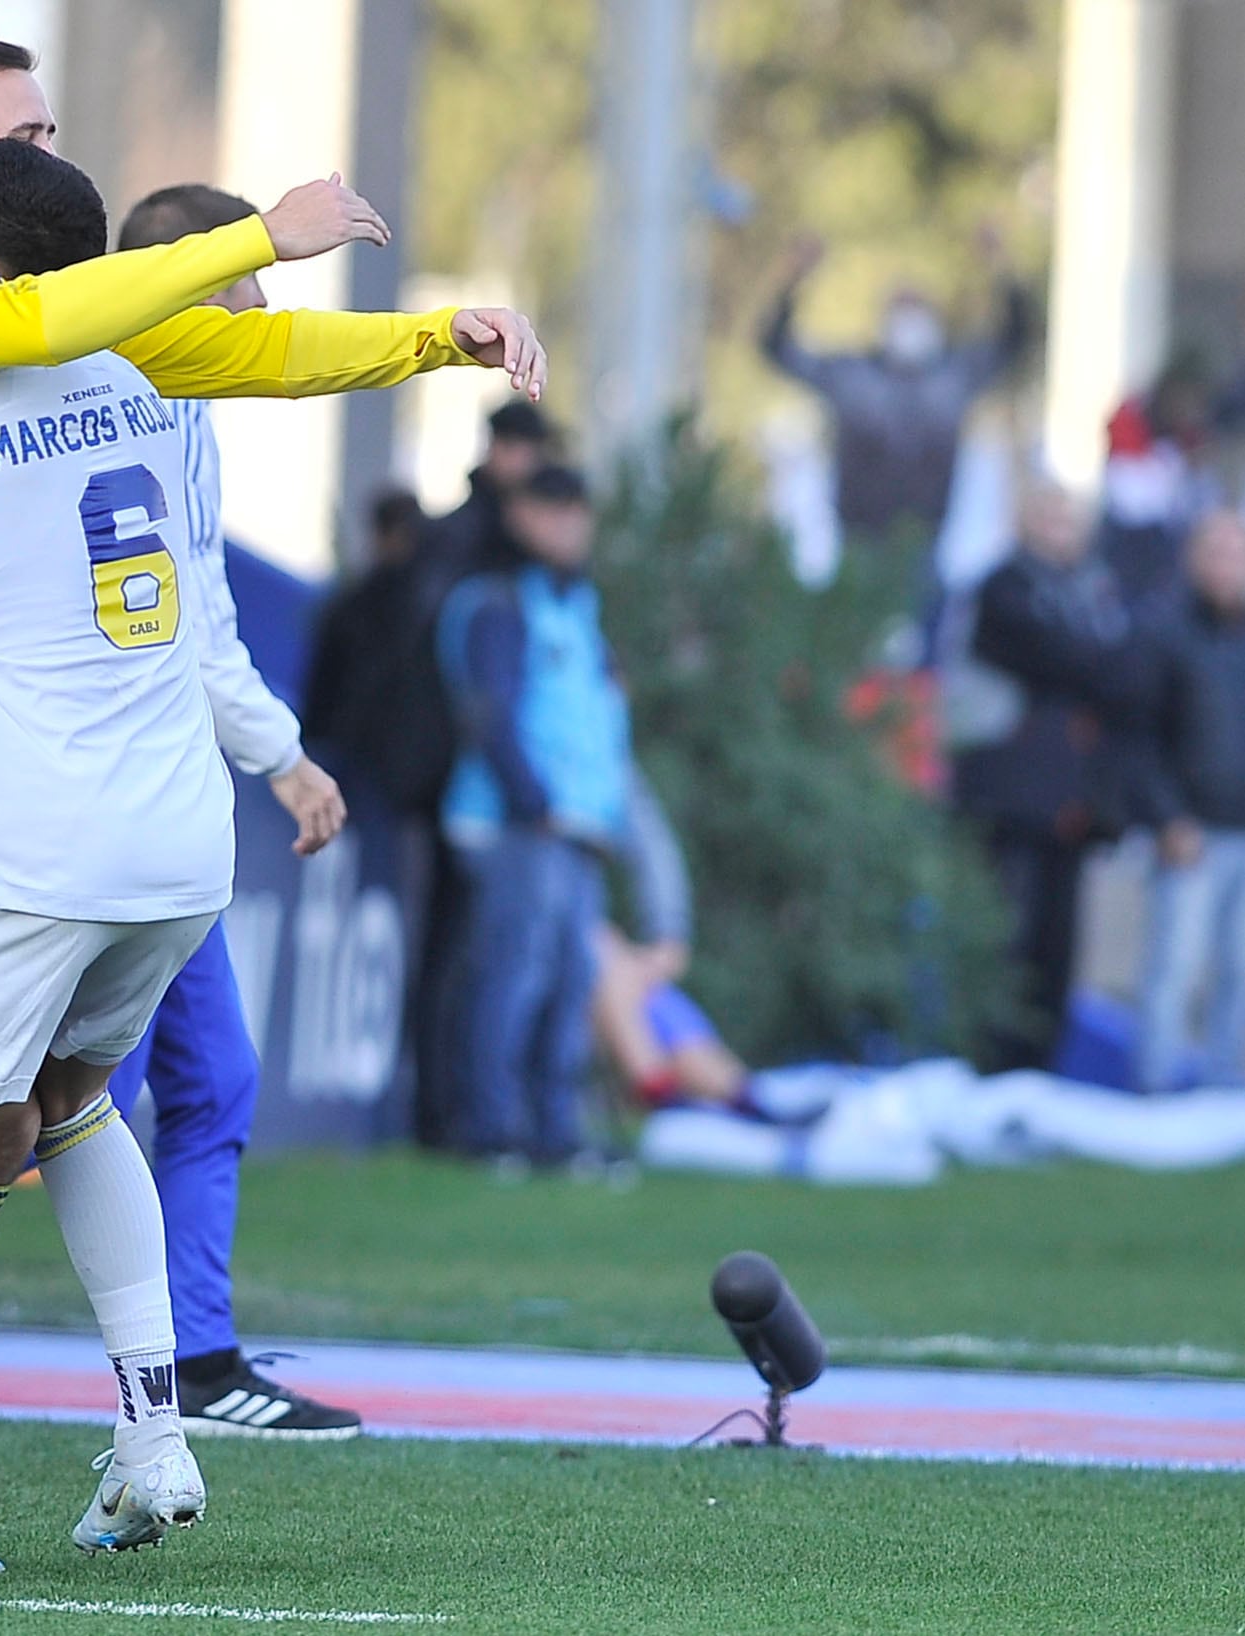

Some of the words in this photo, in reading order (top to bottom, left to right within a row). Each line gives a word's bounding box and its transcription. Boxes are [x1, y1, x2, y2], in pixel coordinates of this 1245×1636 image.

[61, 383, 114, 404] XENEIZE
[77, 463, 181, 651] 6
[129, 620, 160, 636] CABJ
